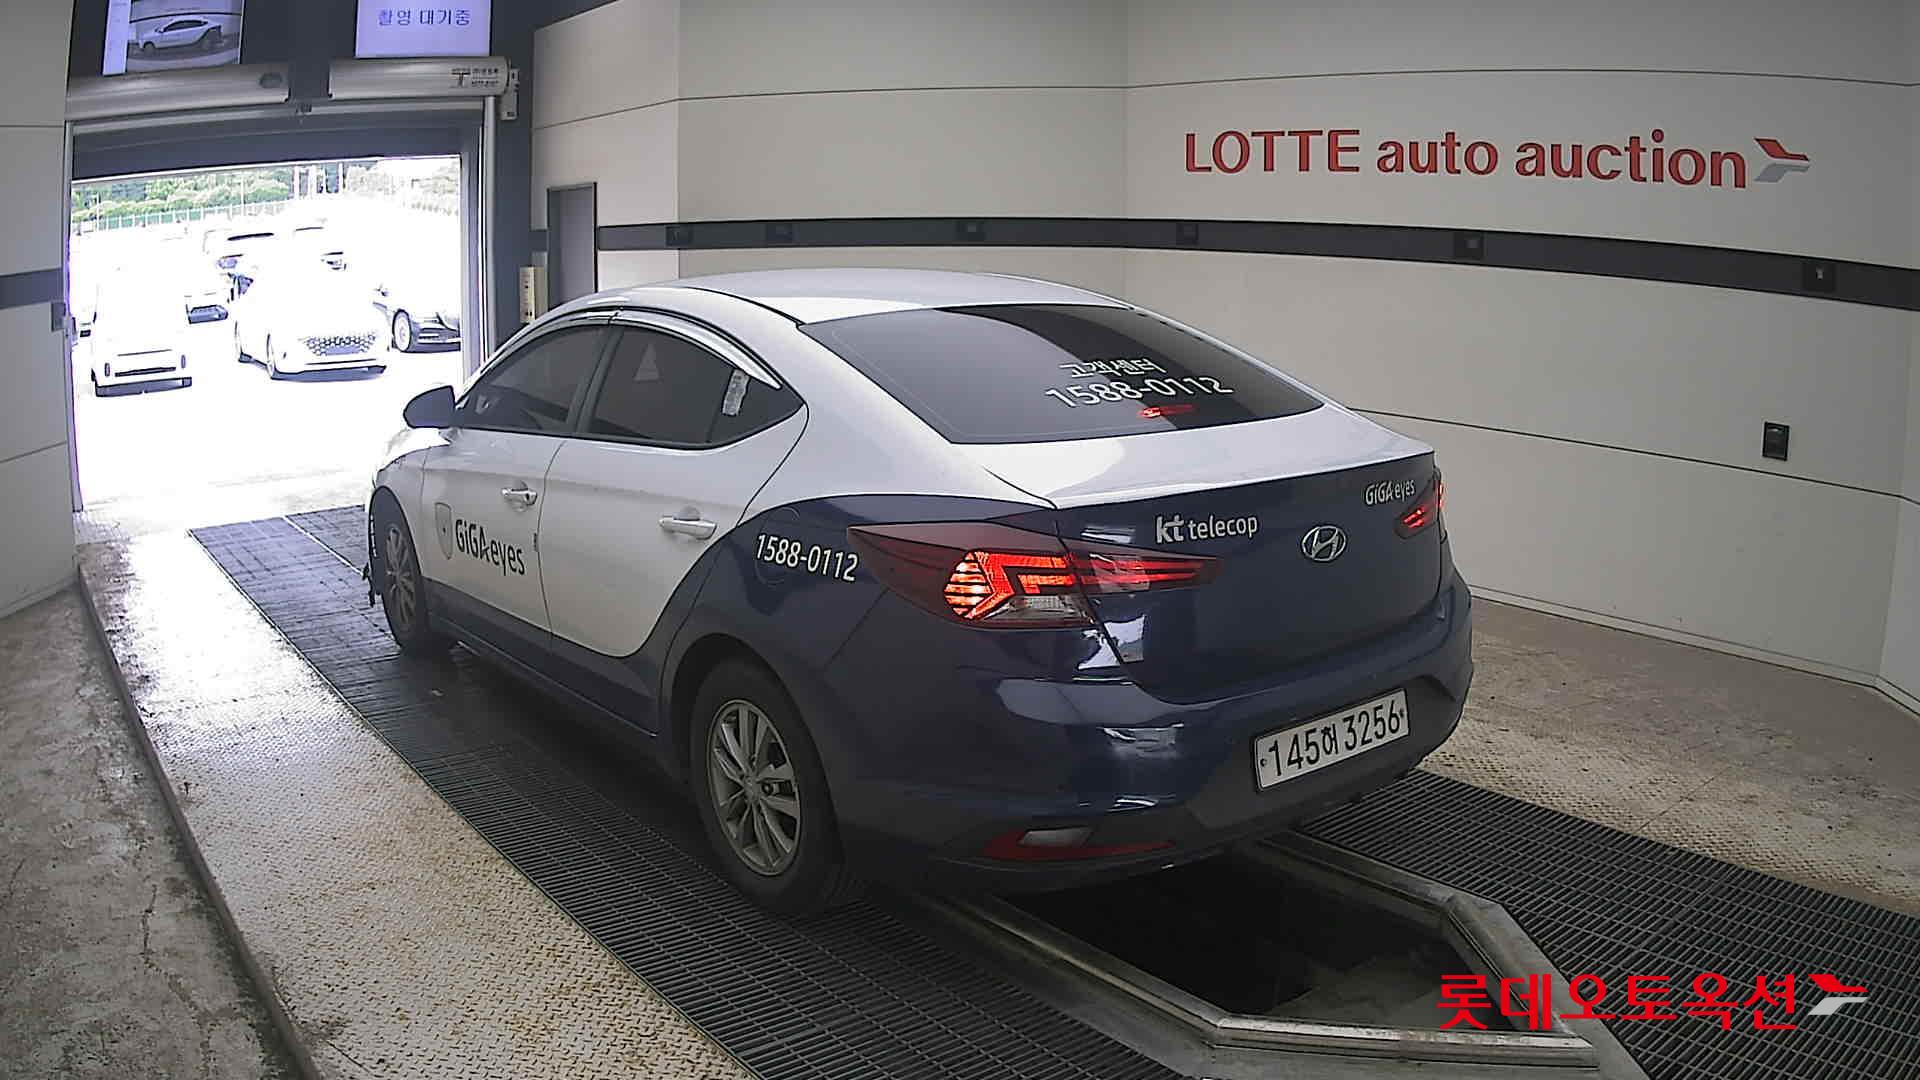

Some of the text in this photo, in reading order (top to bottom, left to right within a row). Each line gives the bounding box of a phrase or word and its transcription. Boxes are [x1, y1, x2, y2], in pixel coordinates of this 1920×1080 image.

[419, 9, 470, 26] 대기중
[1185, 129, 1747, 189] LOTTE auto auction
[1059, 358, 1167, 377] 고객센터
[1045, 377, 1235, 407] 1588-0112
[1156, 515, 1258, 544] kt telecop
[757, 534, 858, 582] 1588-0112
